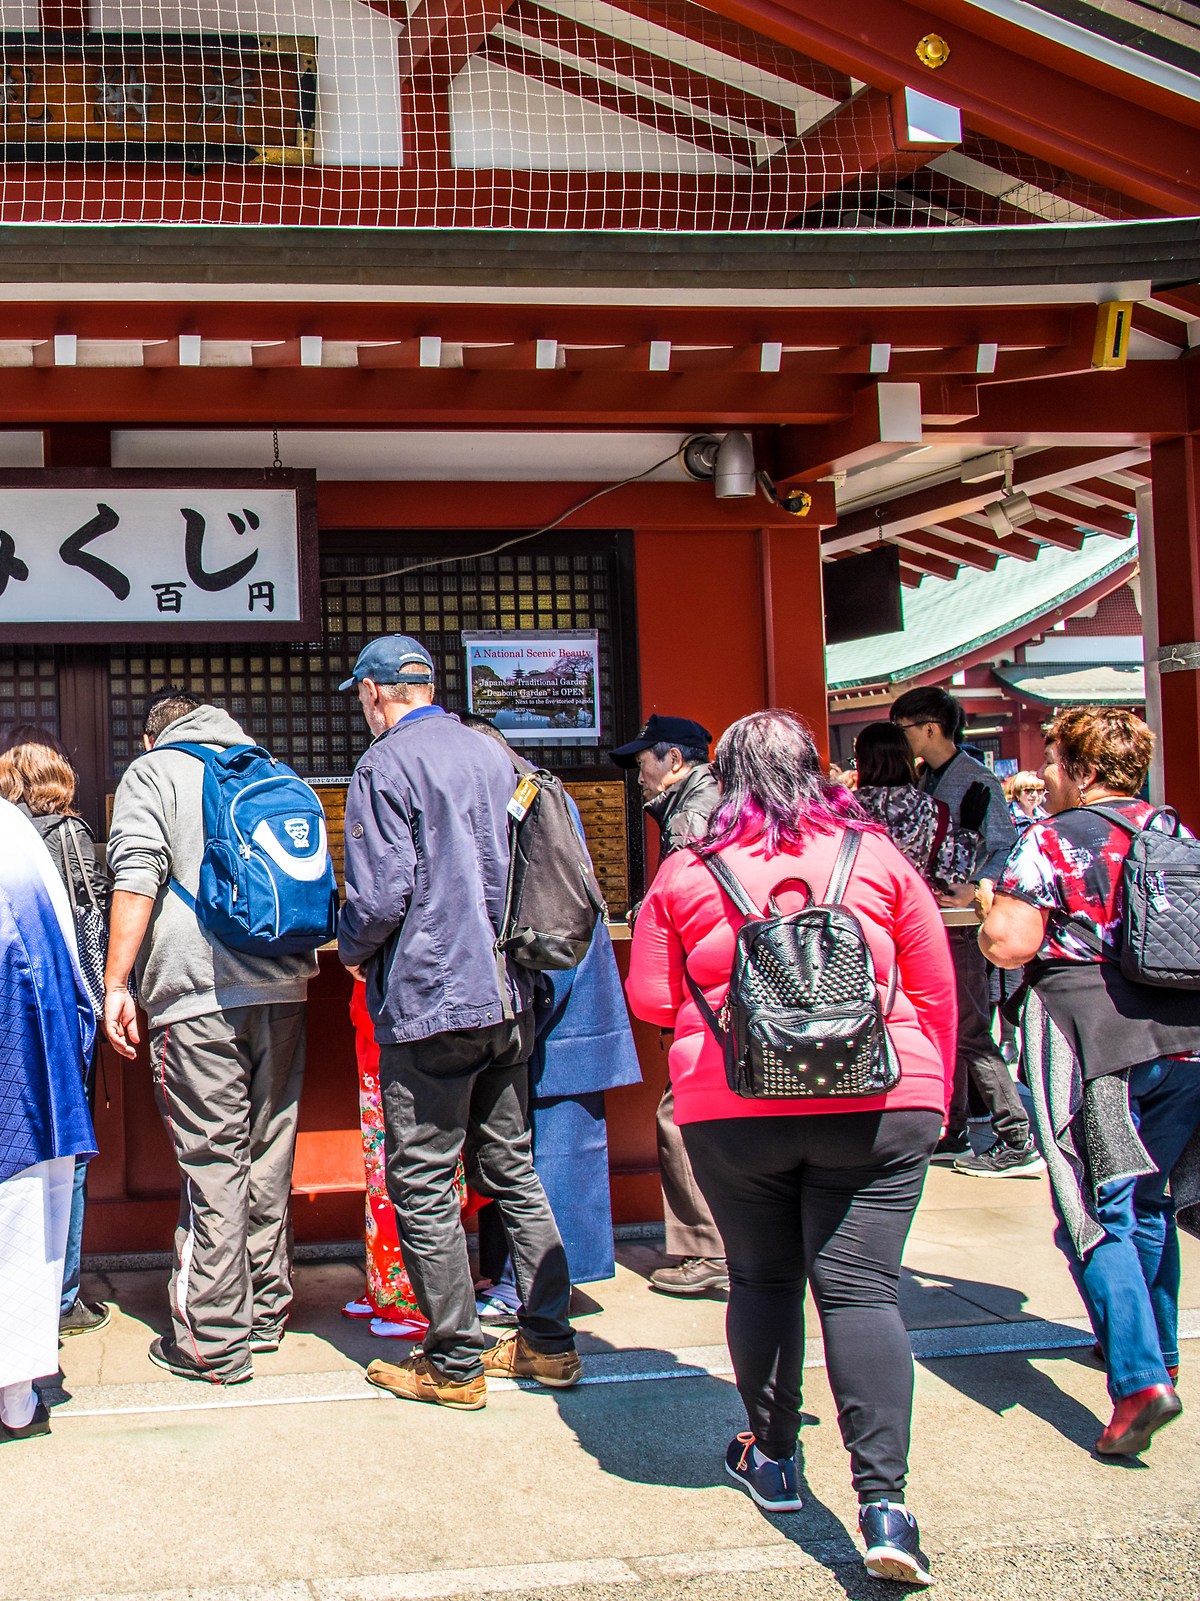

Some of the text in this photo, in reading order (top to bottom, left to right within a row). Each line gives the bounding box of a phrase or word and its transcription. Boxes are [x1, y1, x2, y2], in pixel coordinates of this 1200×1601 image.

[151, 581, 275, 613] 百円
[474, 649, 592, 659] A National Scenic Beauty
[479, 678, 588, 687] Japanese Traditional Garden
[552, 688, 559, 696] is
[560, 687, 585, 696] OPEN
